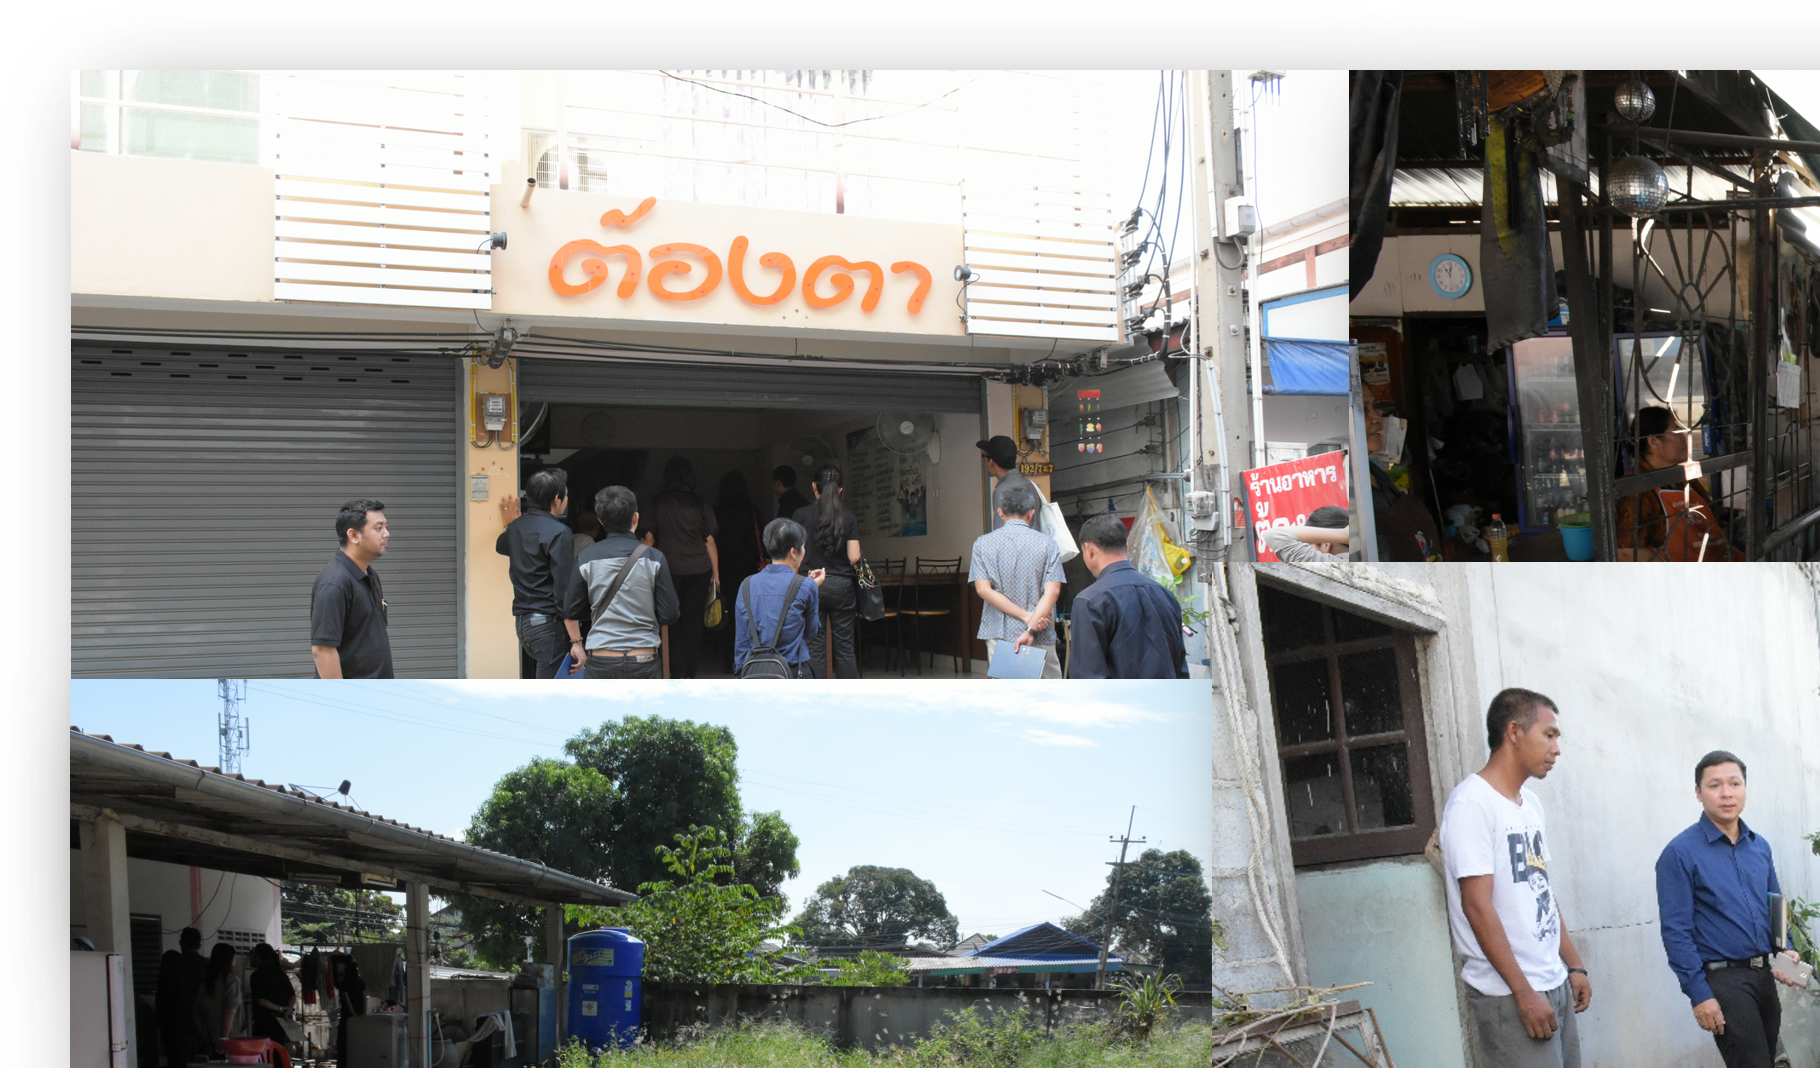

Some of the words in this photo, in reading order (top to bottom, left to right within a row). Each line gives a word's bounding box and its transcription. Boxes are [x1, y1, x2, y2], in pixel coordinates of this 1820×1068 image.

[548, 196, 932, 314] ต้องตา
[1250, 465, 1338, 497] ร้านอาหาร
